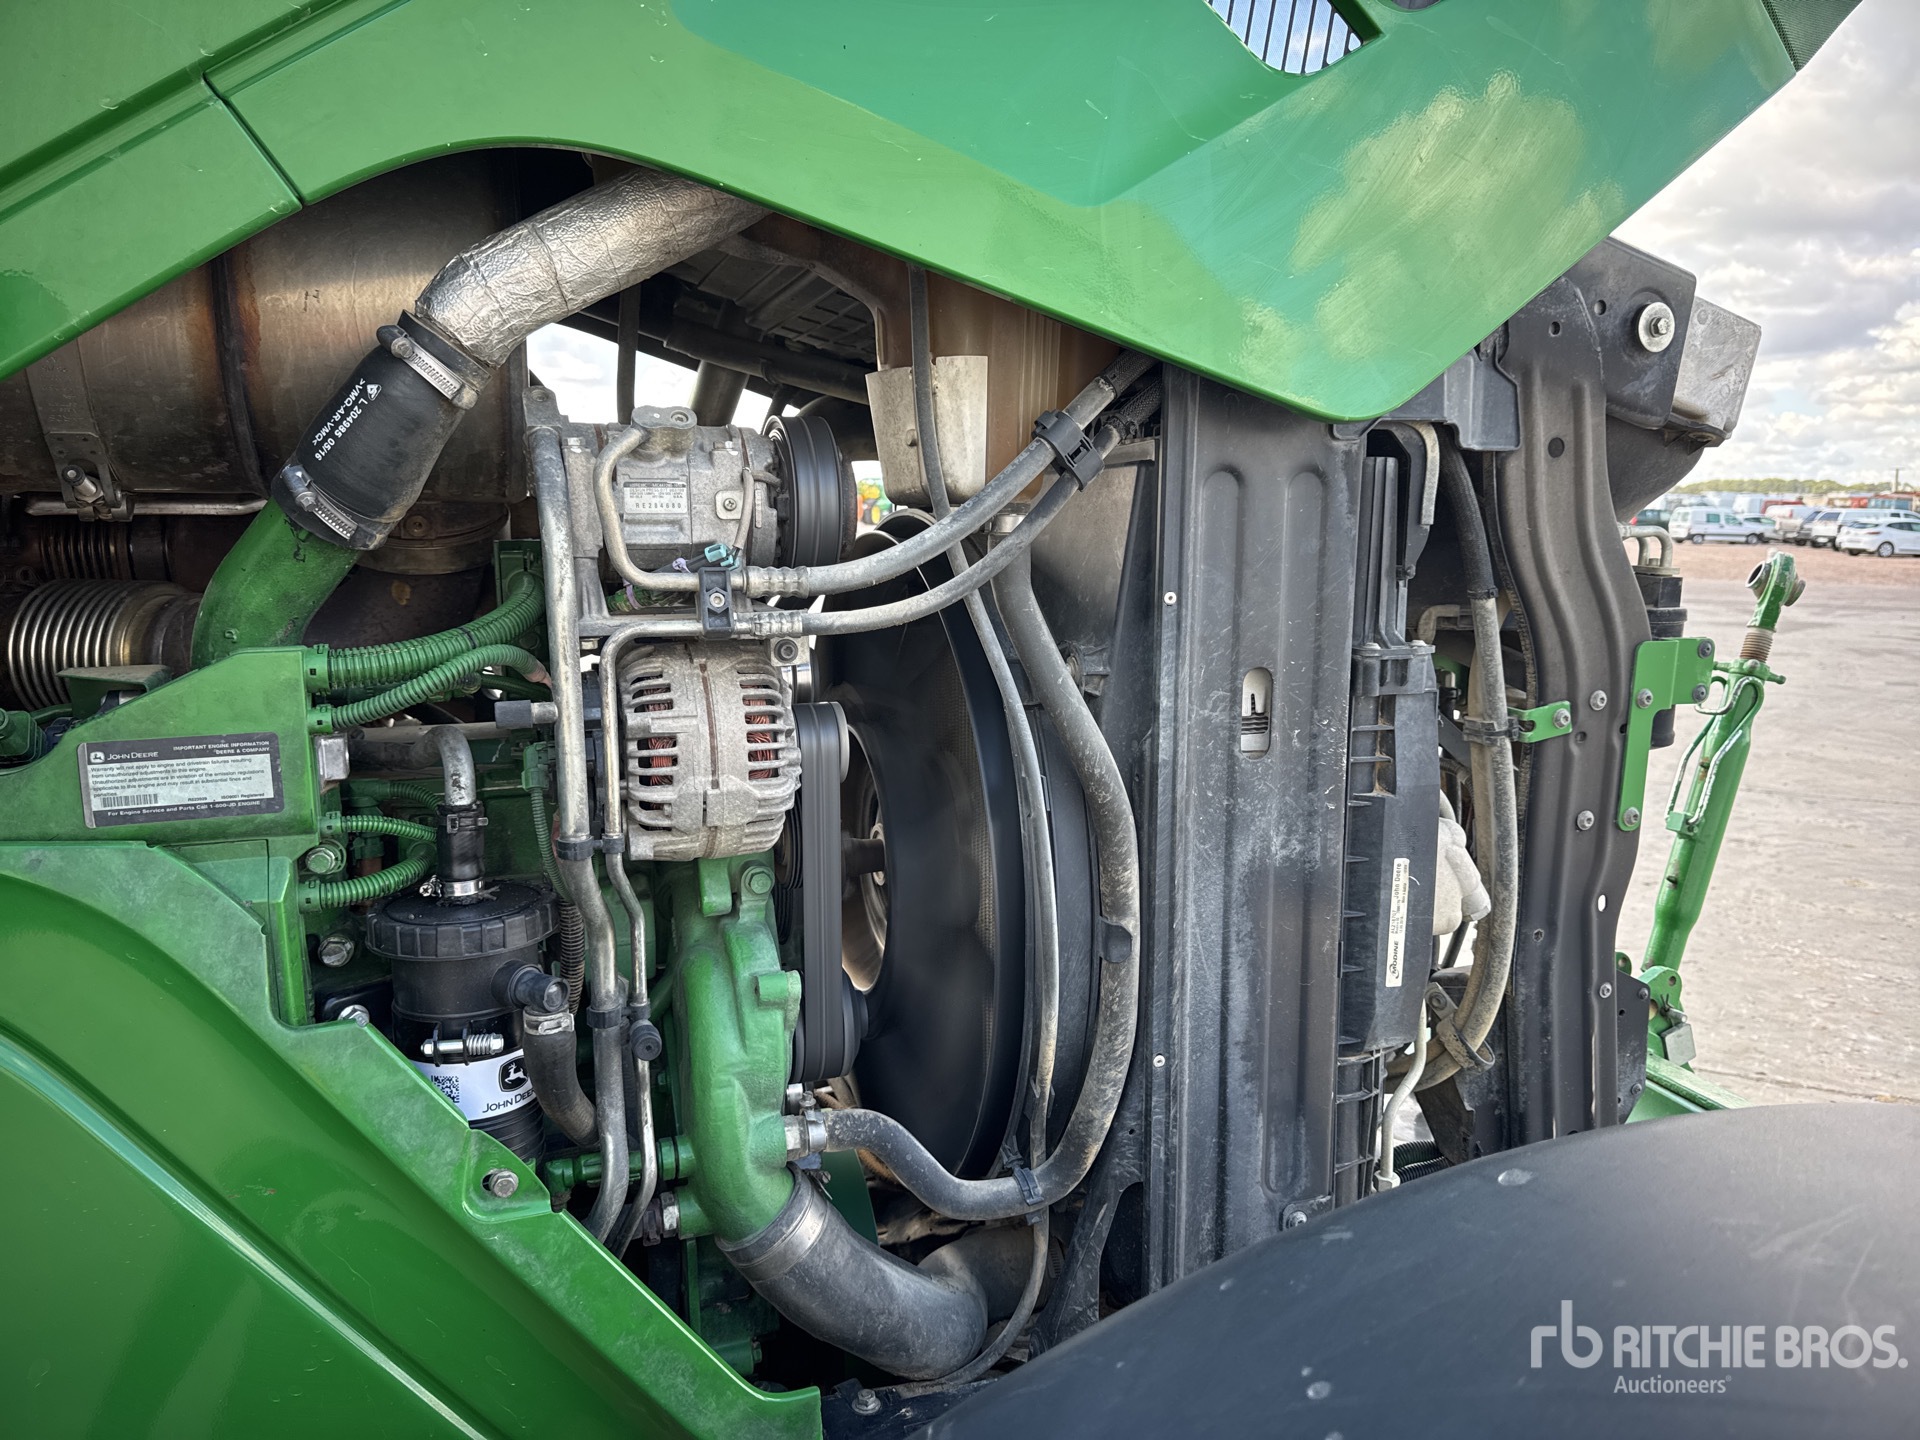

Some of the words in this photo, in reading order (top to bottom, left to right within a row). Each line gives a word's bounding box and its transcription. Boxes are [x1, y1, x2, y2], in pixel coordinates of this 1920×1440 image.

[358, 397, 368, 405] L
[334, 405, 362, 438] 204985
[314, 437, 336, 461] 05/16
[107, 753, 130, 761] JOHN
[131, 751, 159, 759] DEERE
[1394, 863, 1402, 882] Deere
[482, 1098, 513, 1113] JOHN
